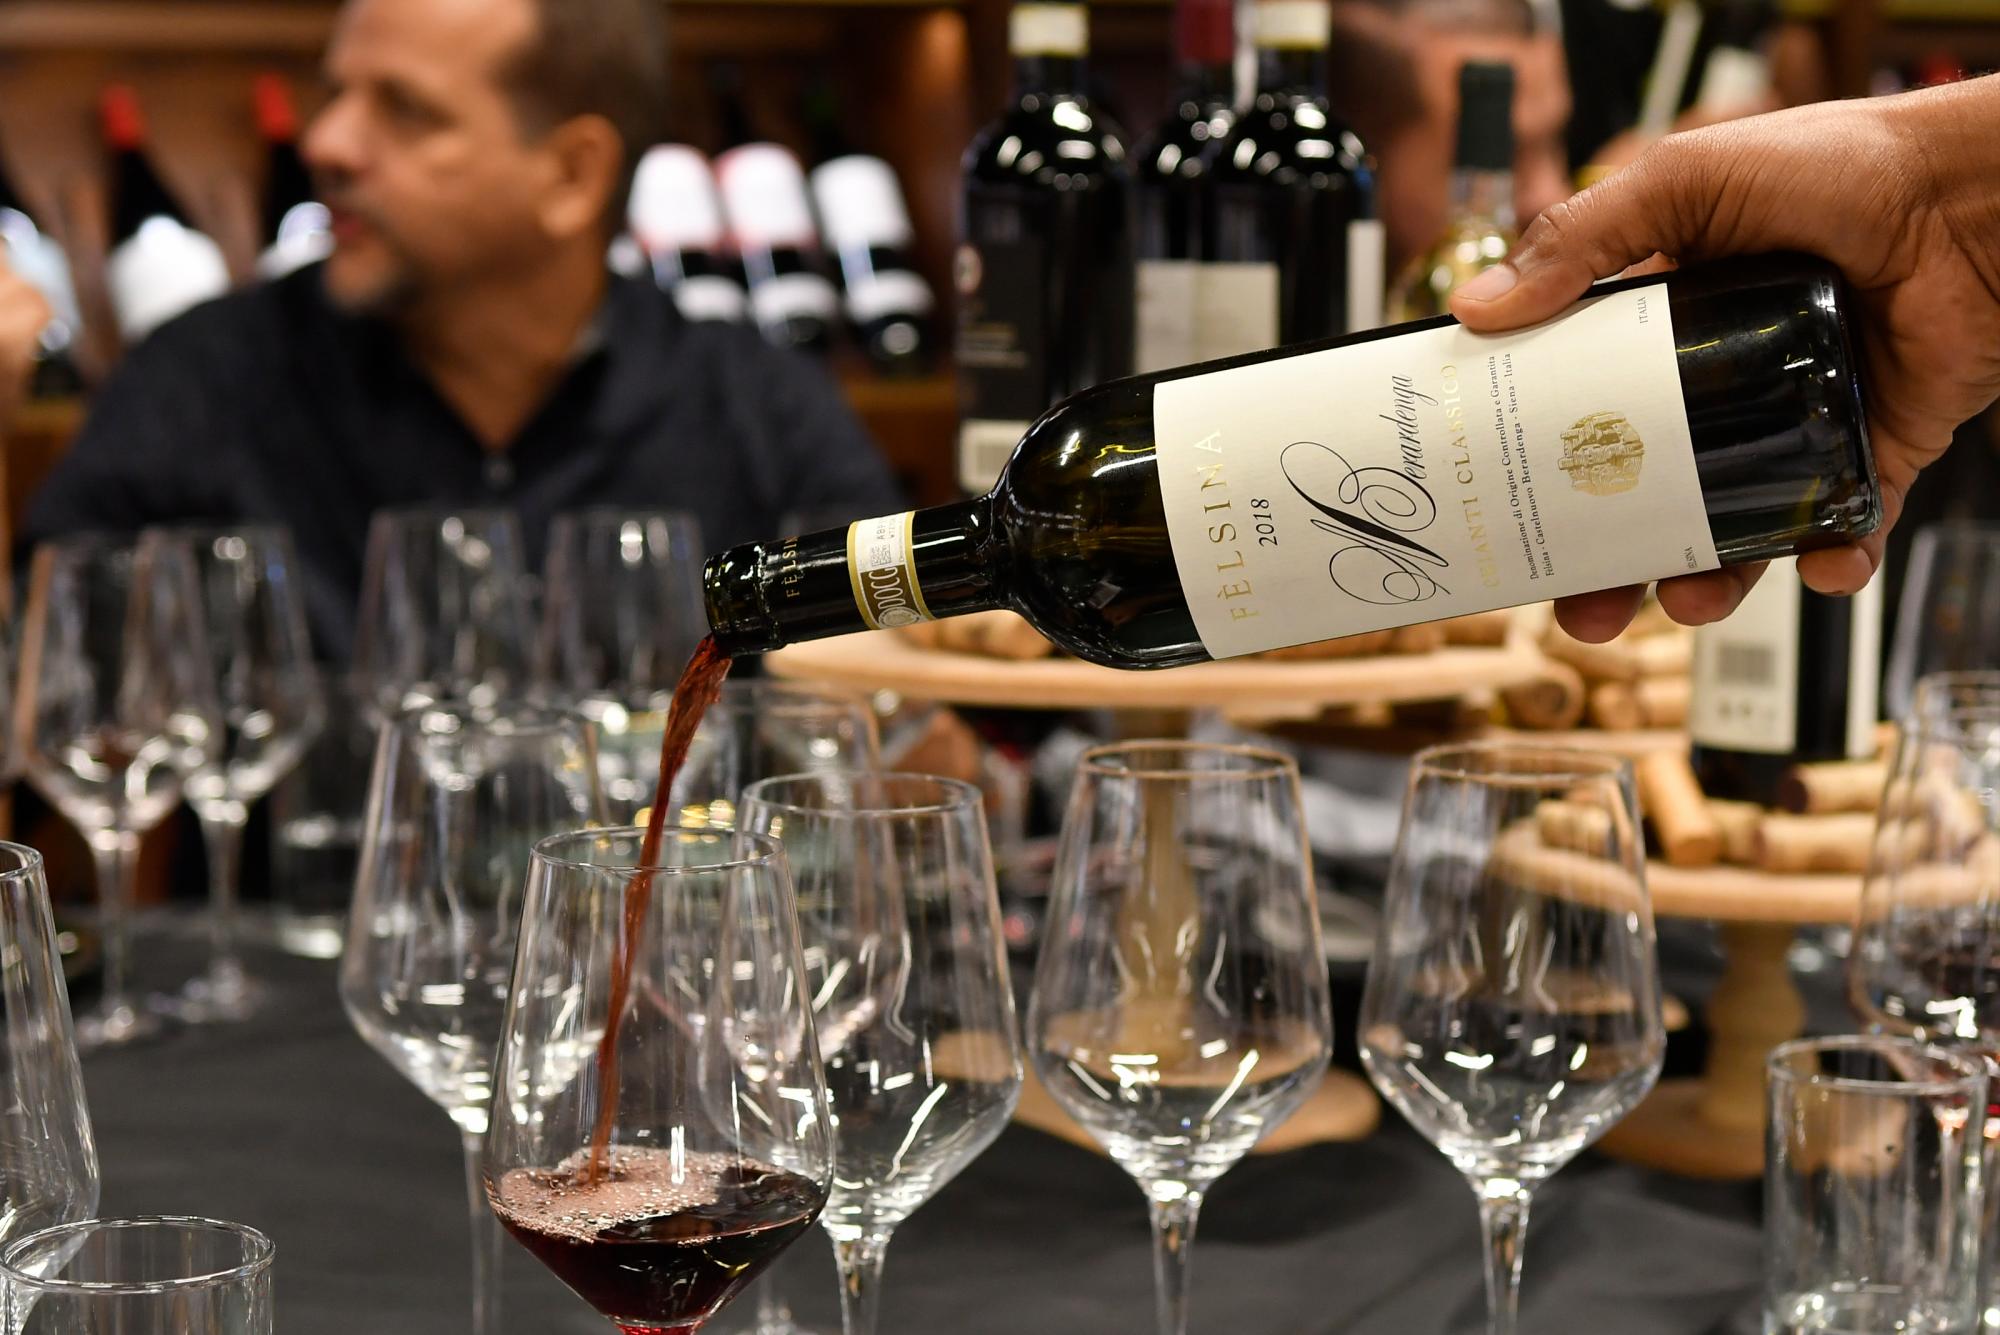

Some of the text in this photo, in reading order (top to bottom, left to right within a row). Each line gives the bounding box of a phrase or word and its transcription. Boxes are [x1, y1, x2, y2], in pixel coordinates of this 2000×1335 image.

[1637, 296, 1648, 324] ITALIA
[1488, 356, 1499, 397] Garantita
[1502, 353, 1513, 377] Italia
[1508, 386, 1518, 413] Siena
[1495, 408, 1511, 466] Controllata
[1514, 423, 1531, 484] Berardenga
[1280, 375, 1451, 605] Berardenga
[1440, 365, 1499, 588] CHIANTI CLASSICO
[1506, 469, 1520, 507] Origine
[1194, 430, 1261, 621] FÈLSINA
[1251, 498, 1278, 547] 2018
[1513, 509, 1522, 519] di
[1527, 487, 1545, 544] Castelnuovo
[1518, 522, 1539, 580] Denominazione
